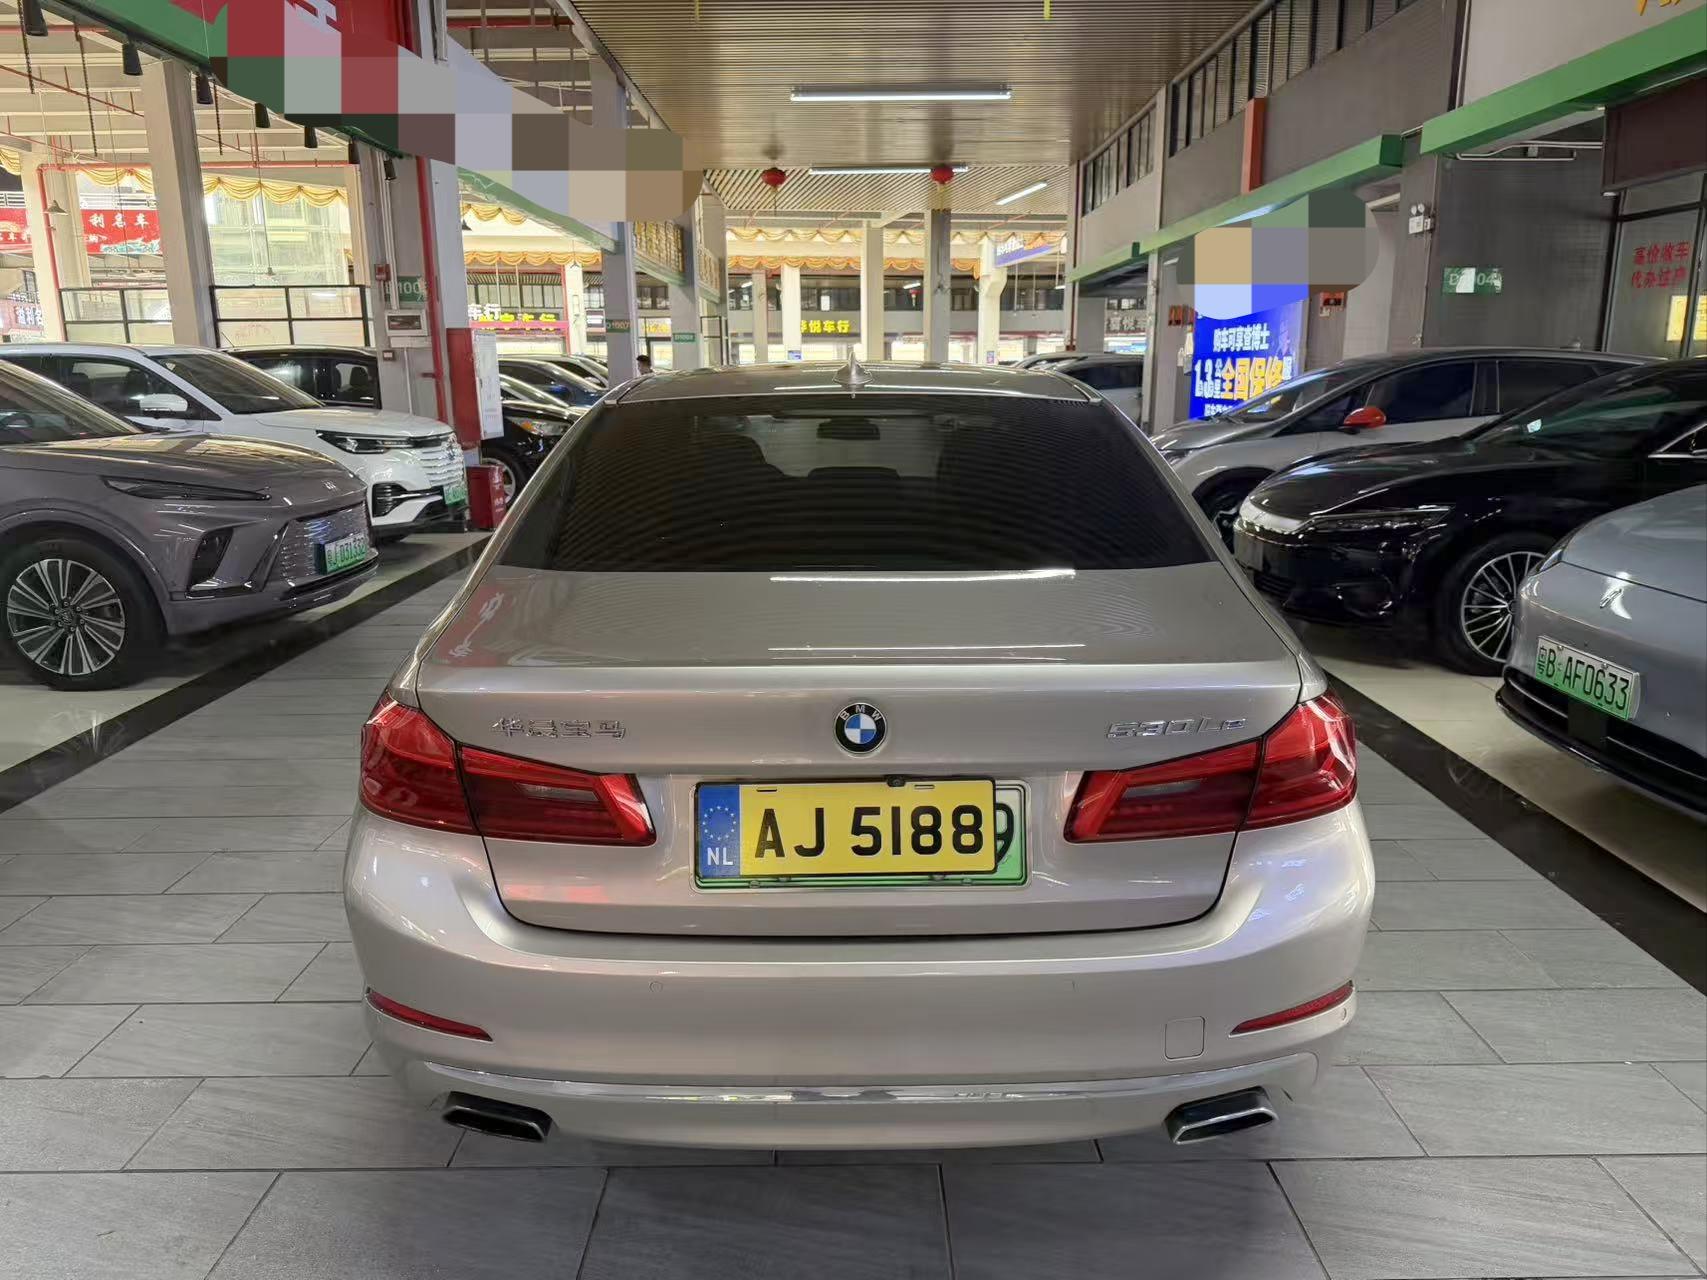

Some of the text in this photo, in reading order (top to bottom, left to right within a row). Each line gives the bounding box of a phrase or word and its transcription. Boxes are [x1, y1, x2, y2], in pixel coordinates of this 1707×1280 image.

[840, 704, 882, 721] BMW
[491, 717, 626, 740] 华晨宝马
[850, 804, 984, 857] 5188
[706, 847, 734, 866] NL
